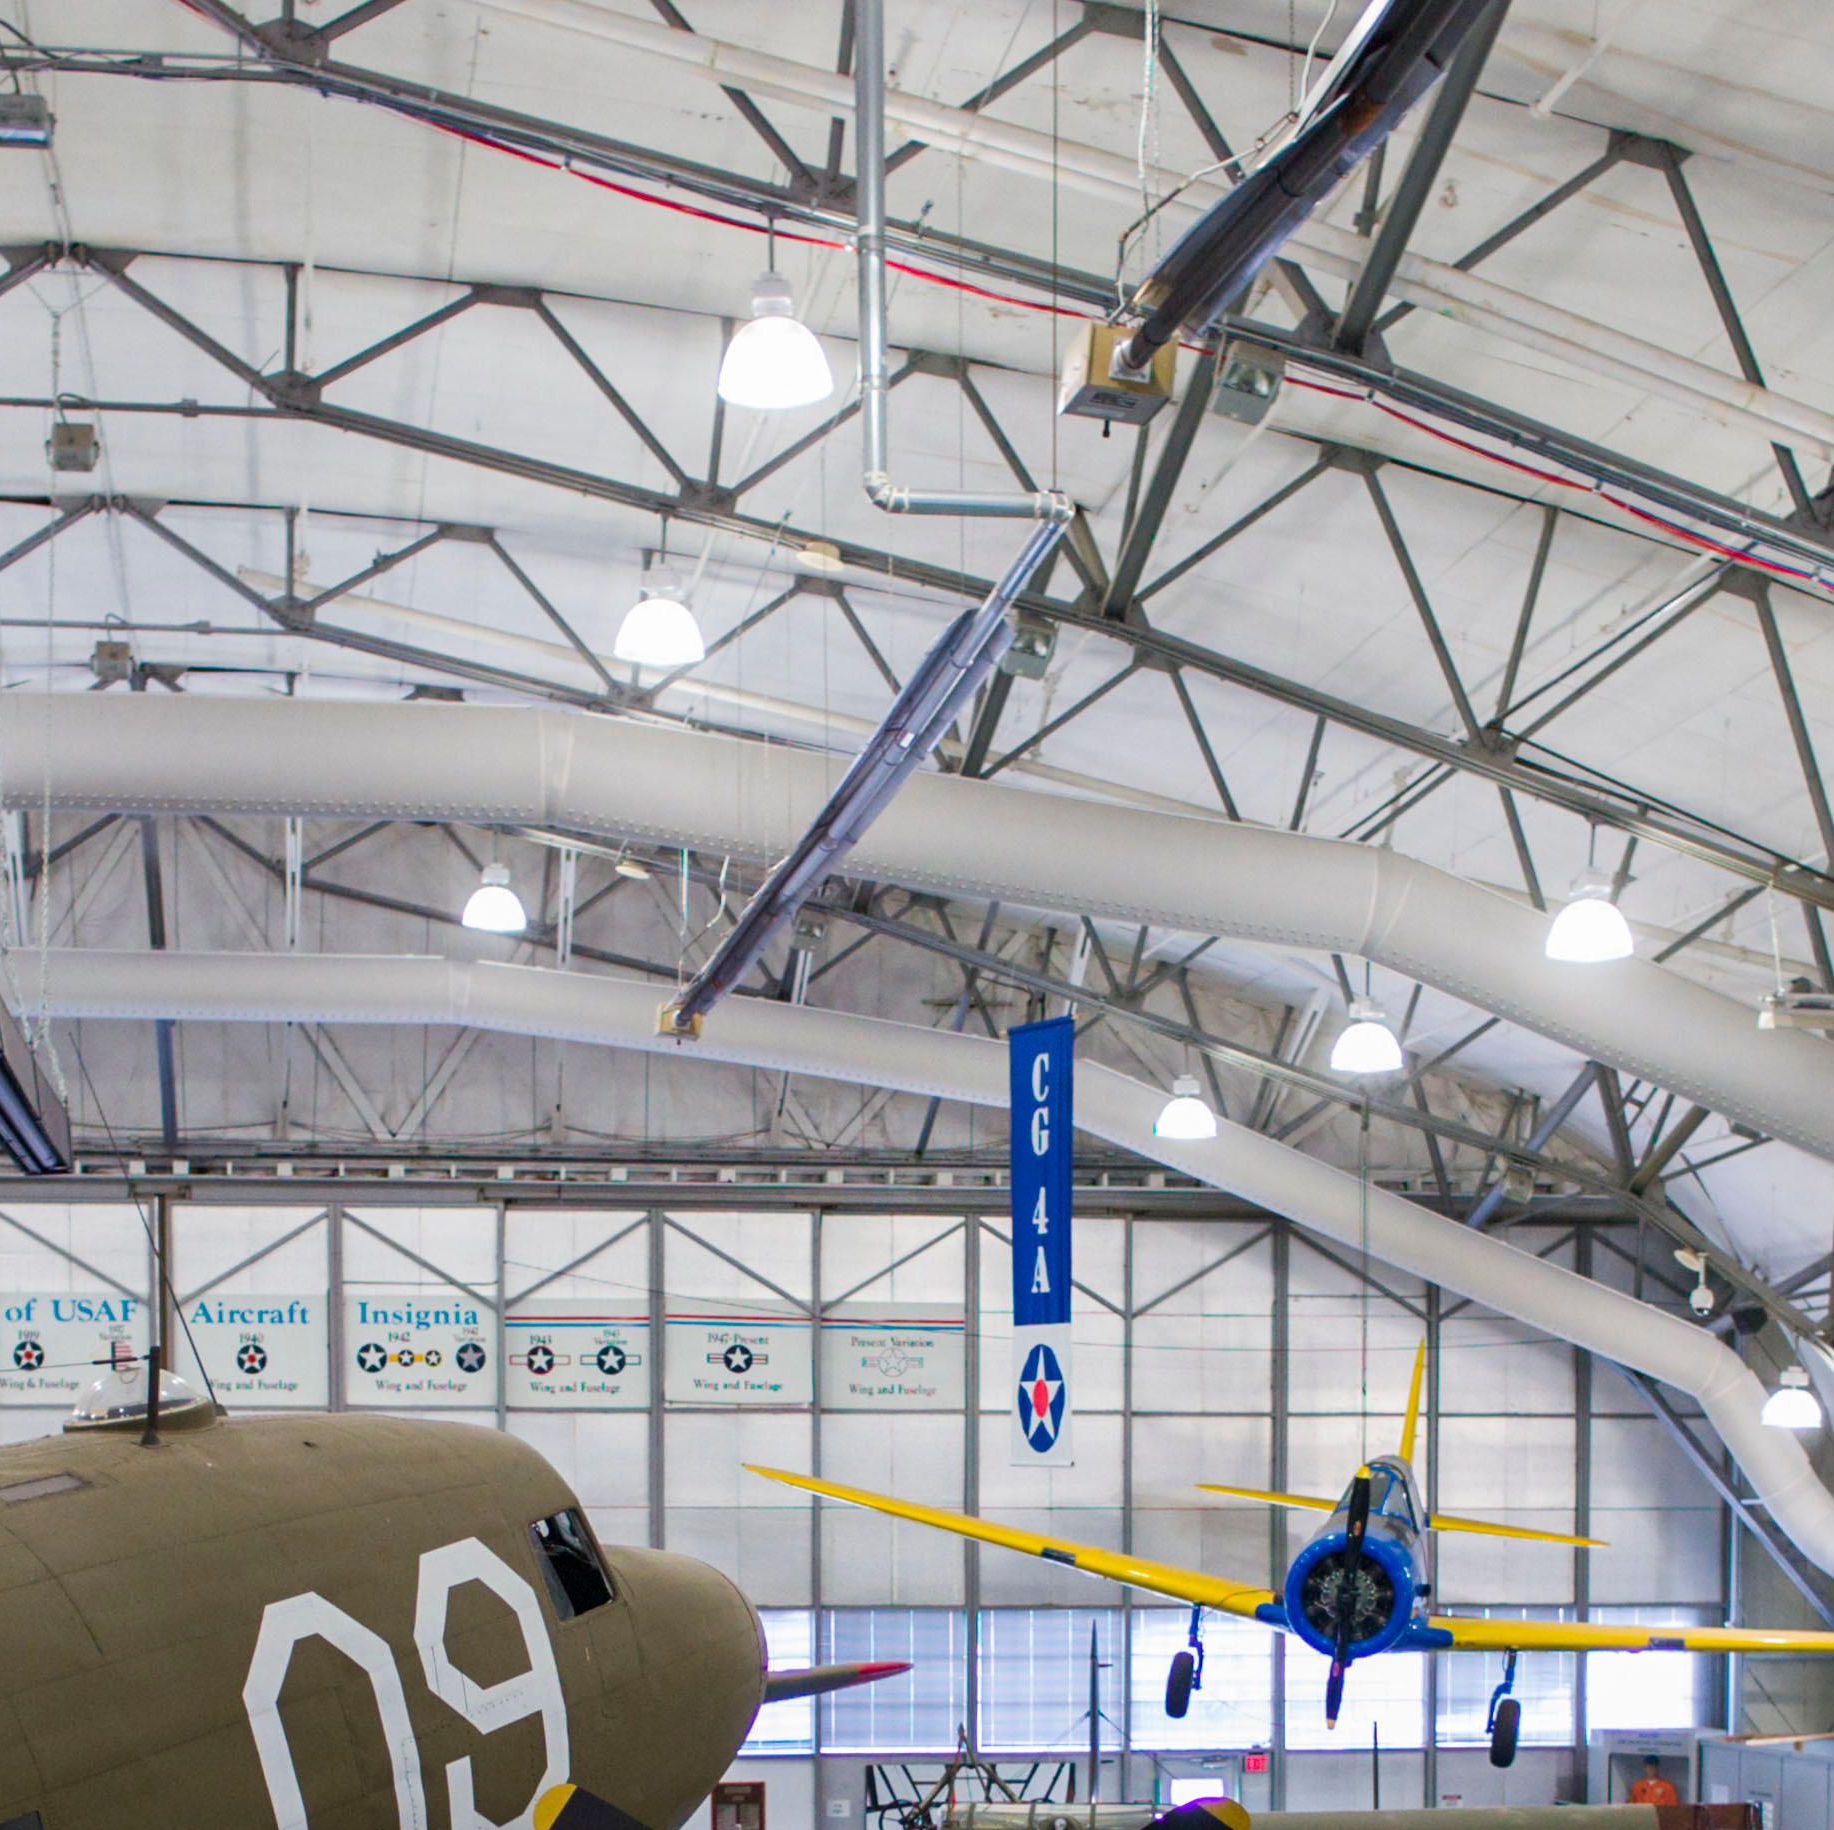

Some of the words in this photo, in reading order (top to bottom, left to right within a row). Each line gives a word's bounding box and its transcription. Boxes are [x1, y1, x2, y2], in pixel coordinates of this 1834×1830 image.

[1031, 1052, 1050, 1157] CG
[1030, 1186, 1051, 1294] 4A
[5, 1298, 38, 1322] of
[51, 1298, 138, 1323] USAF
[190, 1301, 309, 1325] Aircraft
[358, 1302, 479, 1330] Insignia
[239, 1333, 264, 1344] 1940
[387, 1331, 411, 1342] 1942
[851, 1336, 886, 1347] Present
[891, 1336, 934, 1348] Variation
[0, 1377, 24, 1390] Wing
[27, 1378, 35, 1389] &
[39, 1377, 80, 1390] Fuselage
[236, 1380, 254, 1390] and
[258, 1379, 299, 1392] Fuselage
[376, 1379, 401, 1392] Wing
[405, 1380, 423, 1391] and
[427, 1379, 468, 1392] Fuselage
[530, 1382, 556, 1394] Wing
[559, 1382, 577, 1393] and
[581, 1382, 620, 1395] Fuselage
[694, 1378, 719, 1391] Wing
[723, 1380, 740, 1390] and
[744, 1380, 783, 1392] Fuselage
[849, 1384, 874, 1396] Wing
[877, 1384, 895, 1395] and
[898, 1384, 937, 1397] Fuselage
